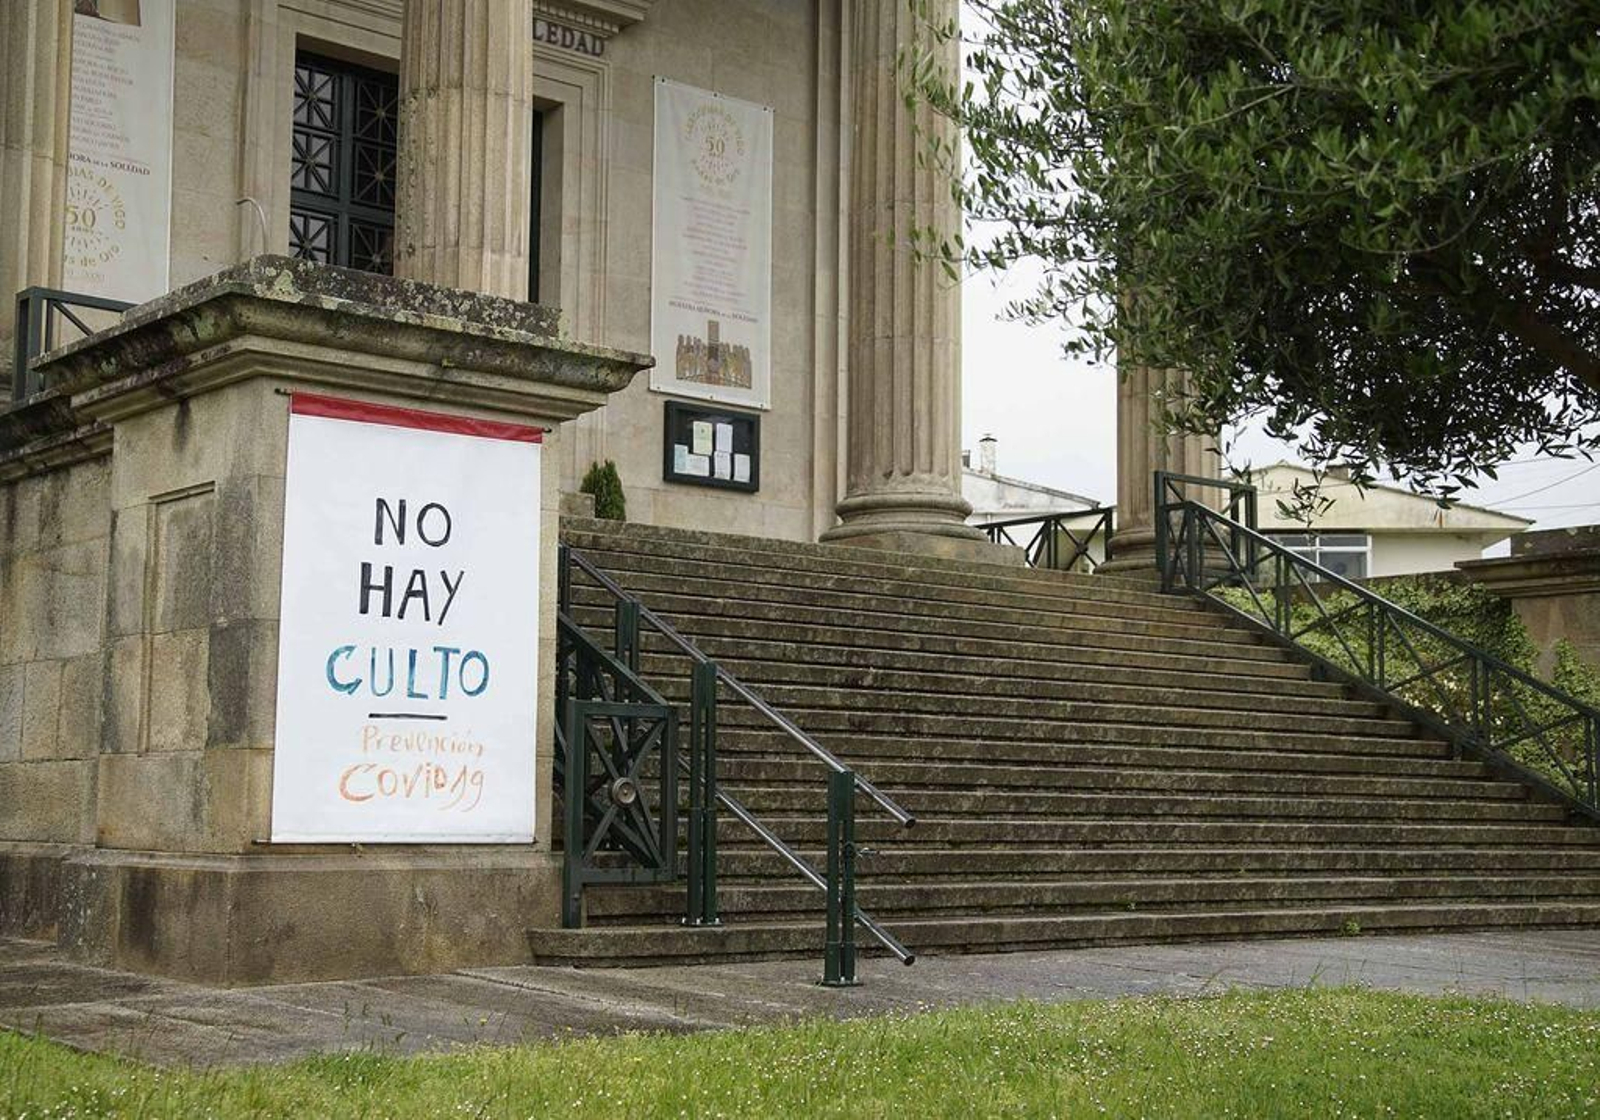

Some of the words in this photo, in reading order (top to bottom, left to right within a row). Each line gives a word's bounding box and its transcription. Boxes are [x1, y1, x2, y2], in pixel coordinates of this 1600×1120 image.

[374, 498, 452, 547] NO
[358, 562, 465, 626] HAY
[325, 645, 490, 701] CULTO
